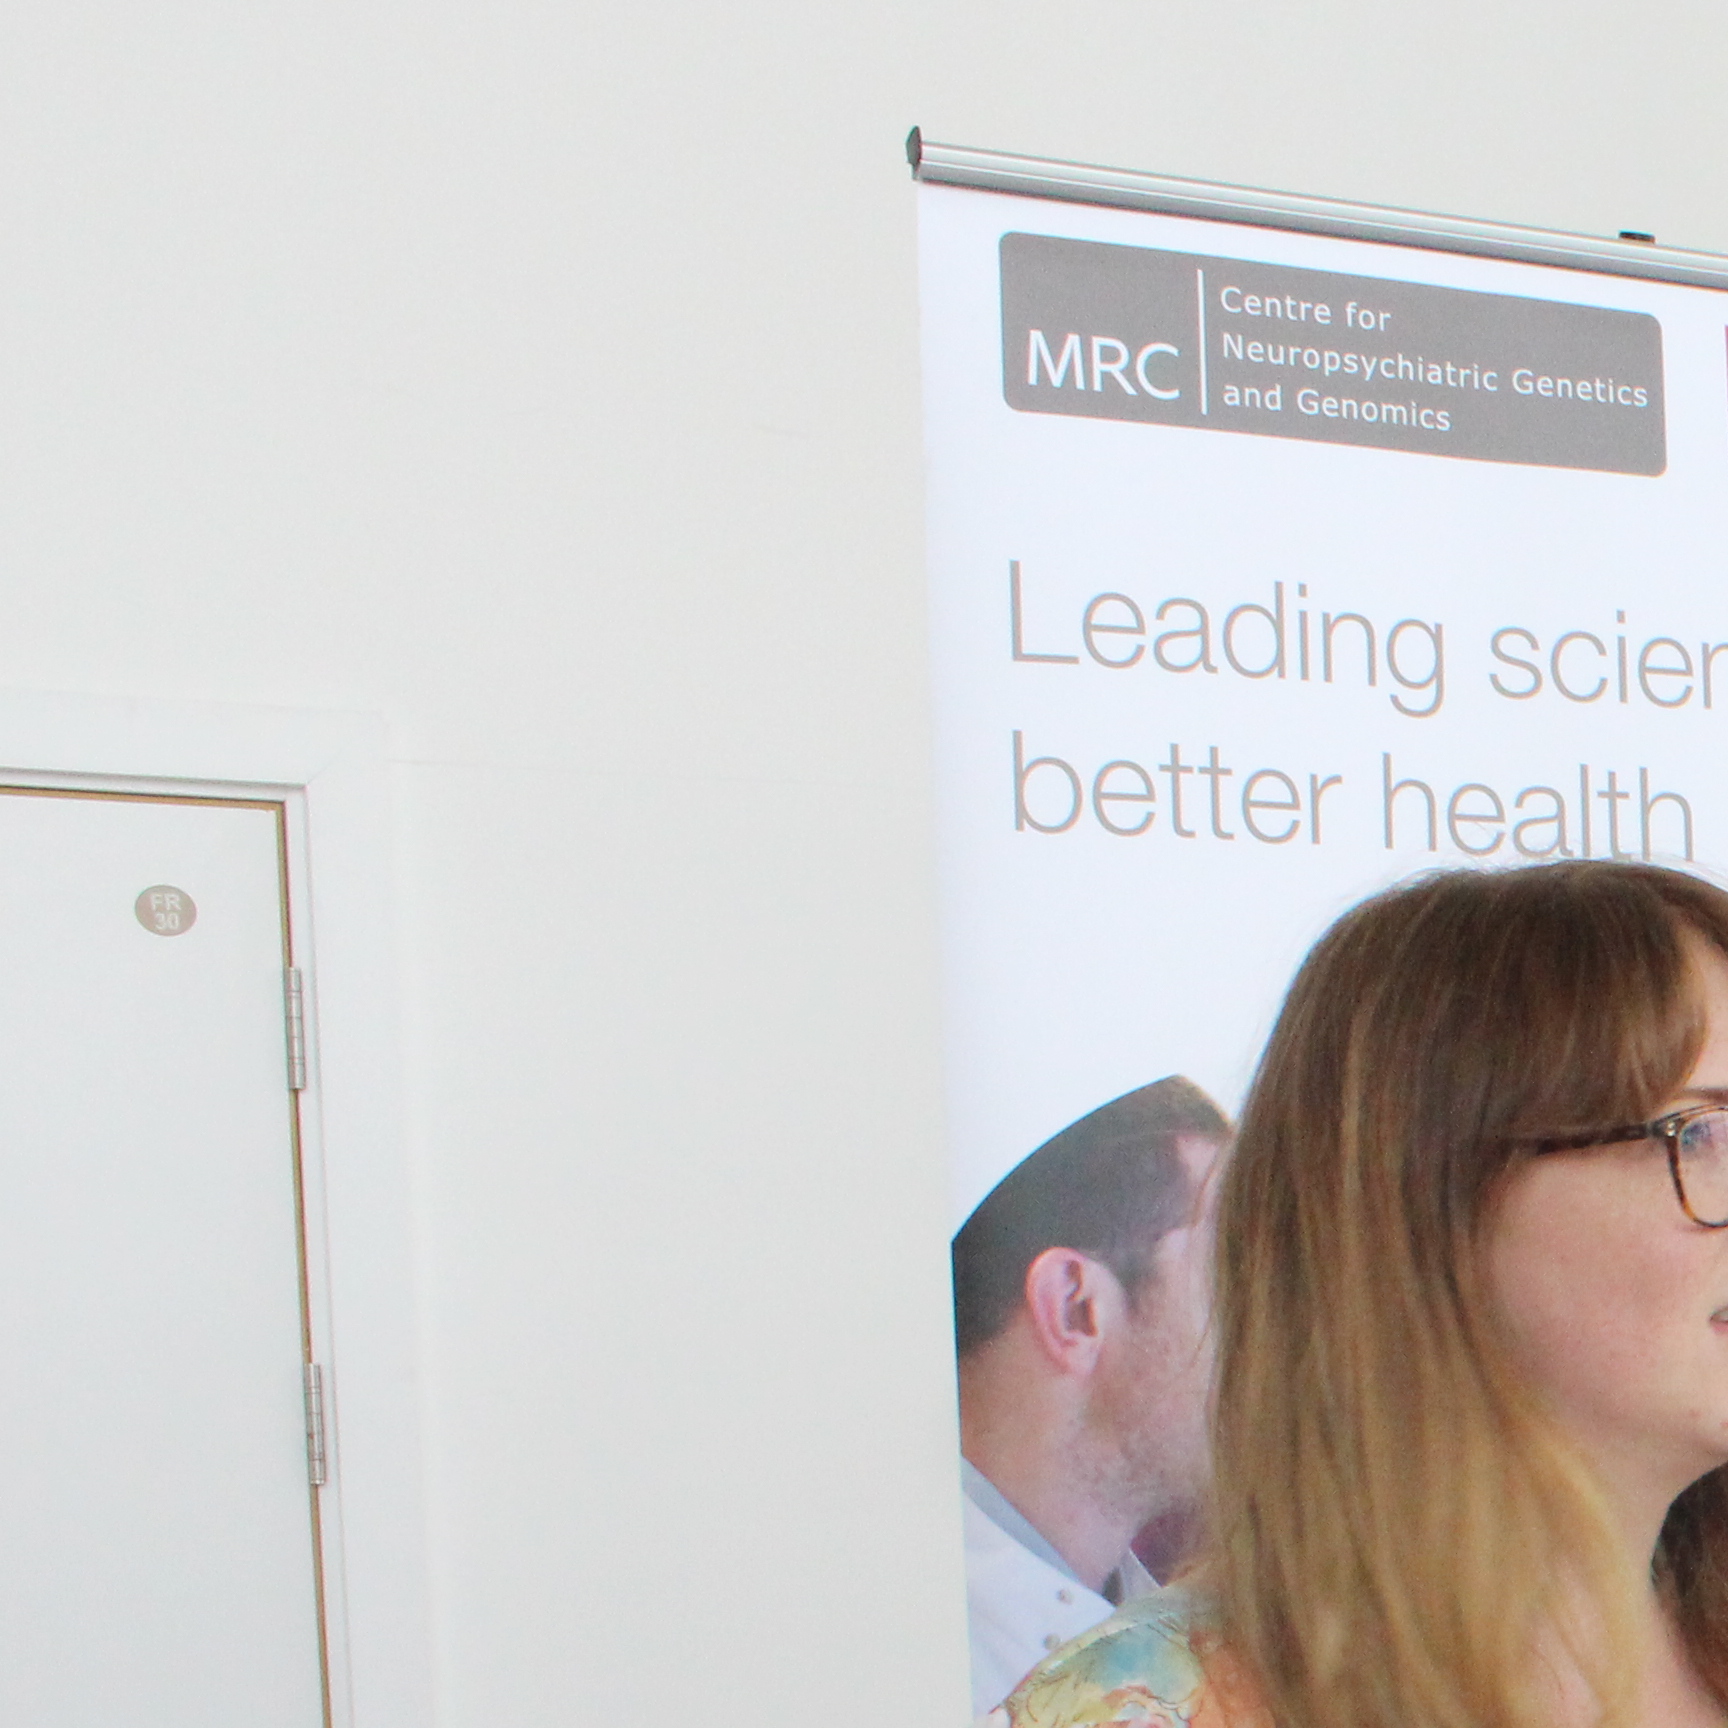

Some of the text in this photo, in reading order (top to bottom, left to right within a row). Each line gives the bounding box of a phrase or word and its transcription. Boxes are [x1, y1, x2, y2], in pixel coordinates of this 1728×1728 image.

[1220, 286, 1392, 333] Centre for
[1027, 328, 1181, 400] MRC
[1222, 332, 1649, 408] Neuropsychiatric Genetics
[1223, 380, 1452, 432] and Genomics
[1008, 558, 1446, 719] Leading
[1011, 729, 1696, 865] better health
